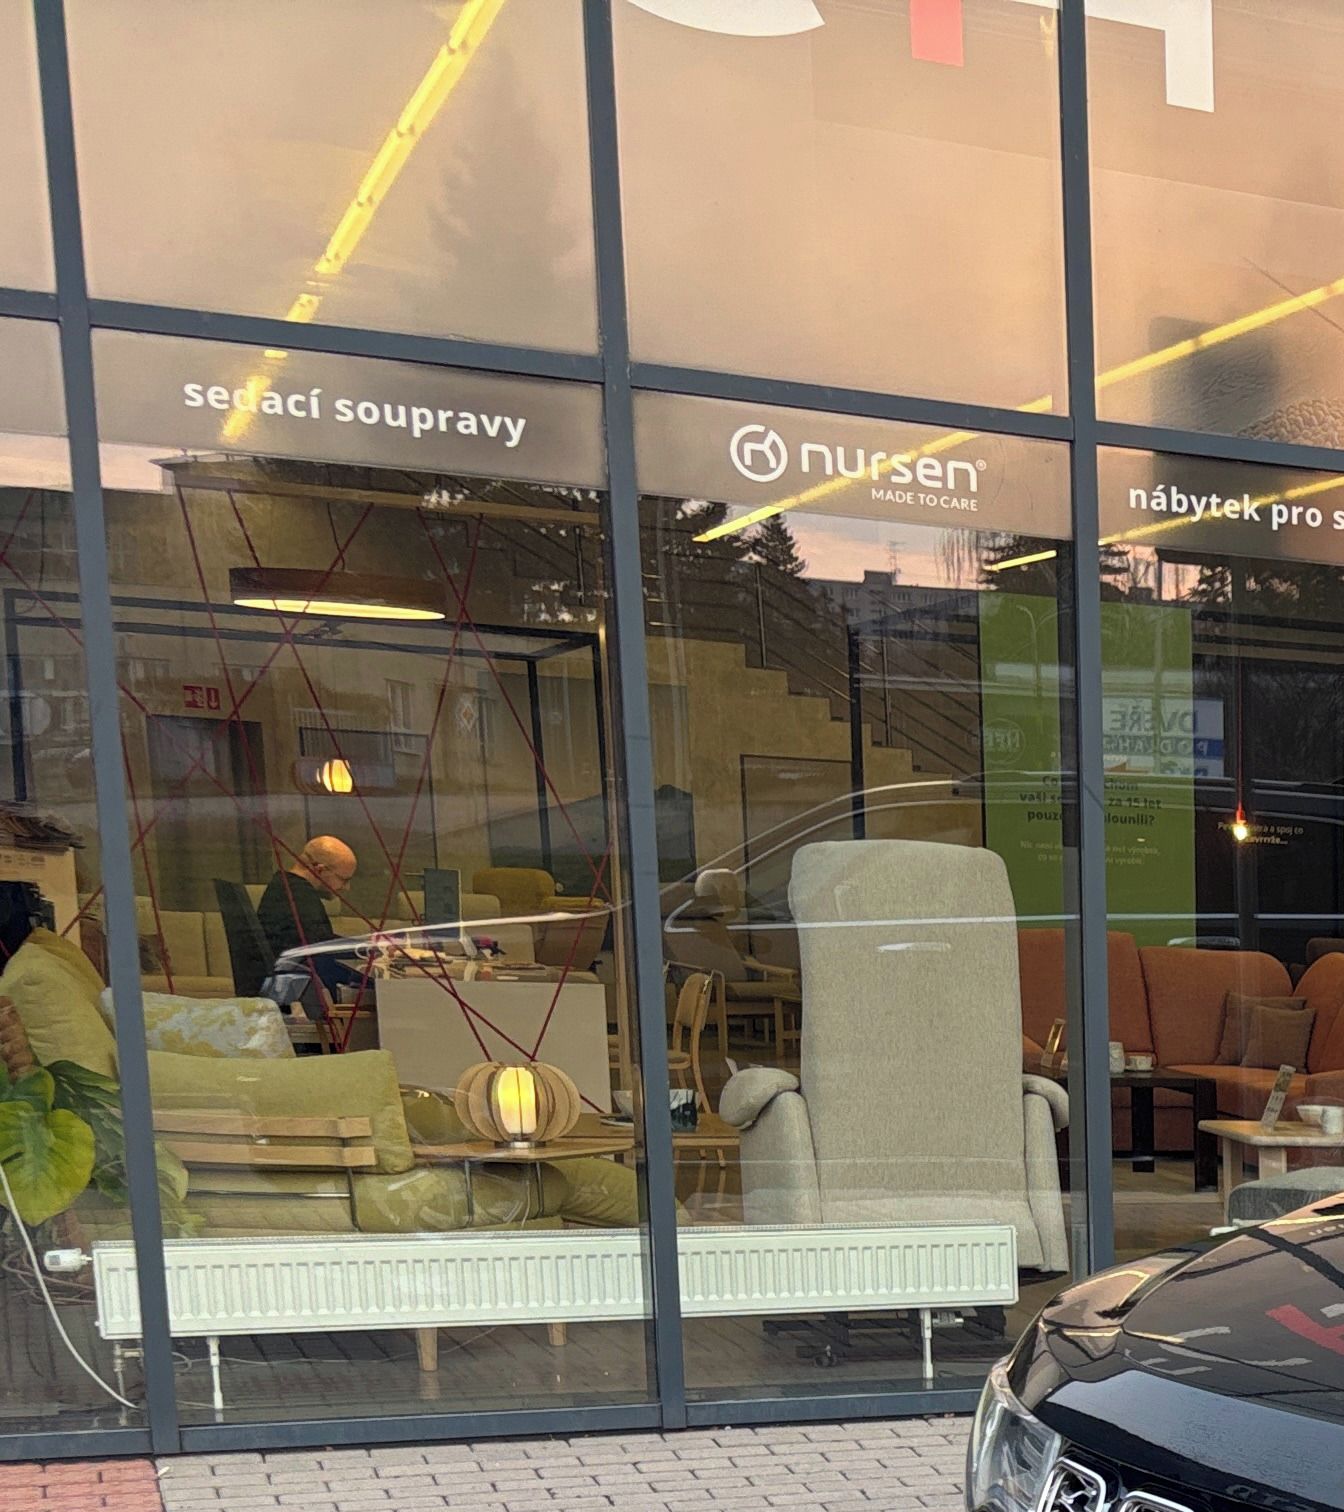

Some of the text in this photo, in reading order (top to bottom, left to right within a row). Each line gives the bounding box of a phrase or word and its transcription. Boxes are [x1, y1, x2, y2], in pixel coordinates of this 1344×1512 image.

[183, 379, 527, 448] sedací soupravy
[871, 488, 979, 512] MADE TO CARE
[1128, 485, 1262, 522] nábytek
[1271, 502, 1323, 530] pro
